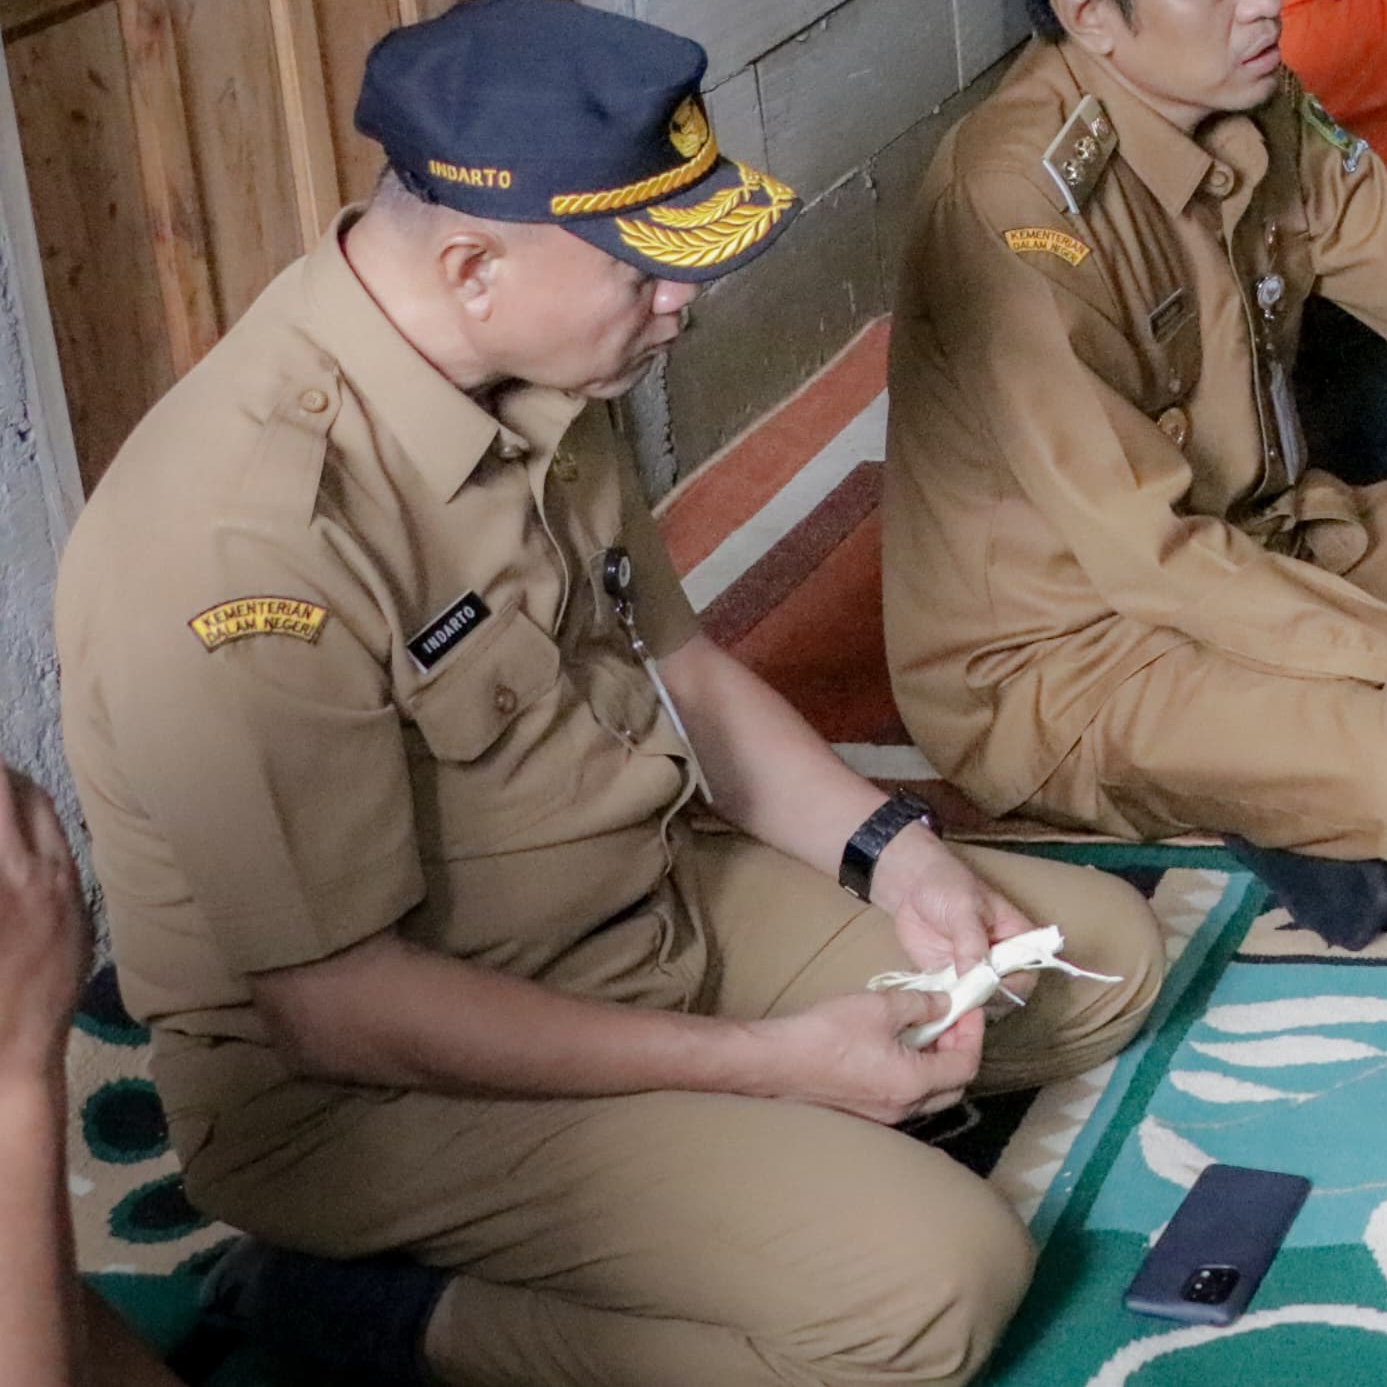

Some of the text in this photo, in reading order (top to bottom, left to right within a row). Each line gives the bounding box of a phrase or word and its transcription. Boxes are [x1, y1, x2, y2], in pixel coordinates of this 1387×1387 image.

[428, 160, 511, 188] INDARTO
[1010, 230, 1085, 254] KEMENTERIAN
[202, 600, 314, 626] KEMENTERIAN
[422, 605, 475, 654] INDARTO
